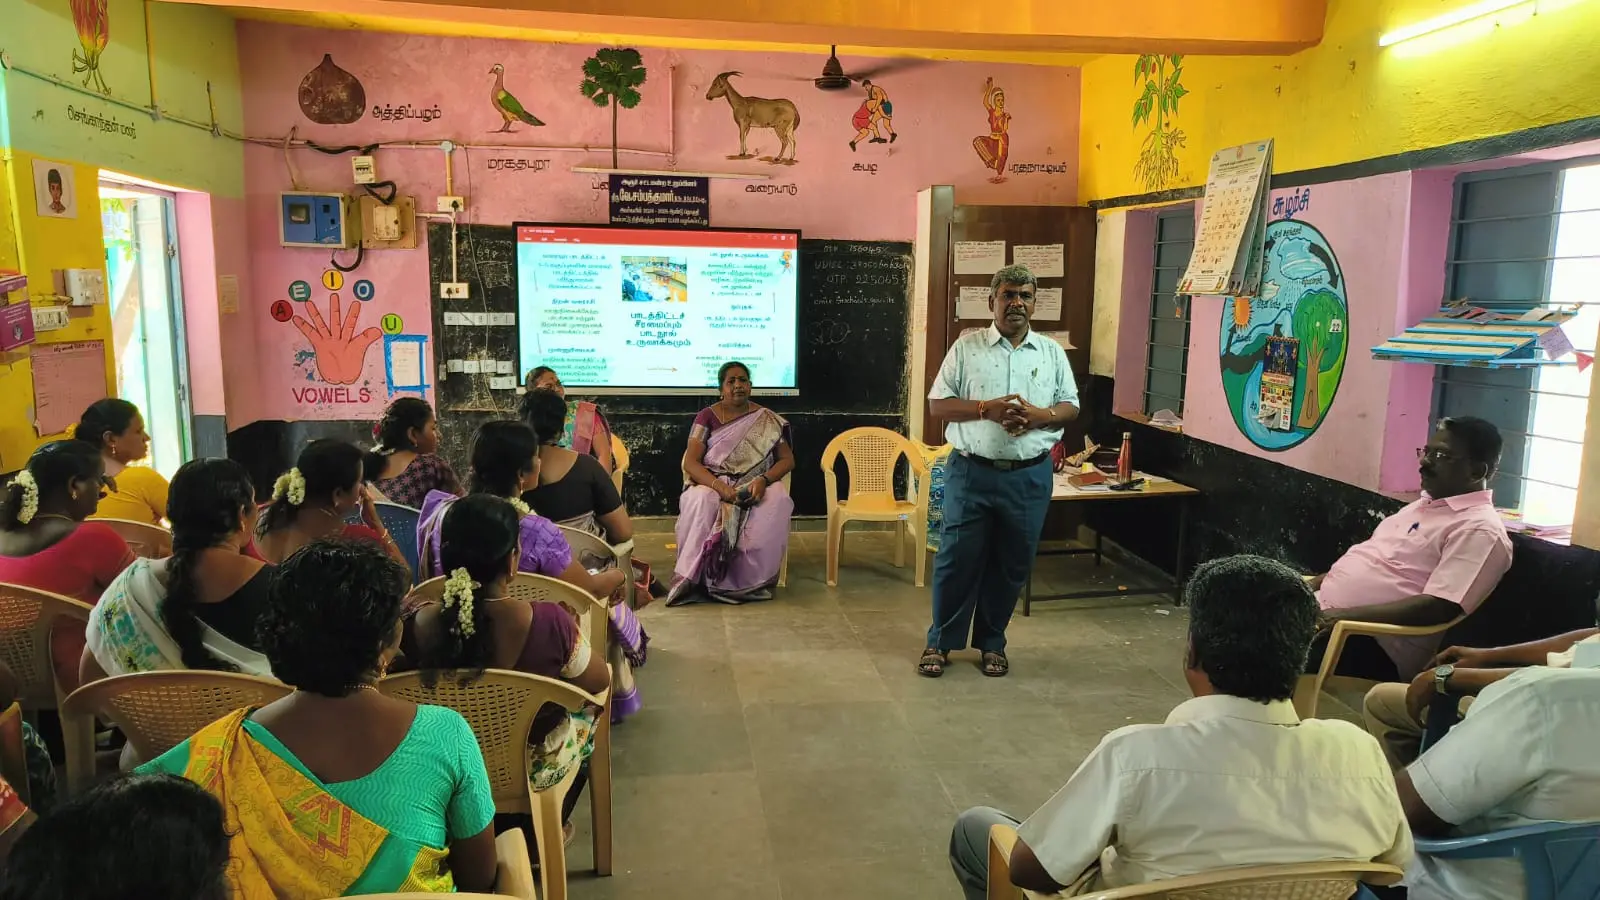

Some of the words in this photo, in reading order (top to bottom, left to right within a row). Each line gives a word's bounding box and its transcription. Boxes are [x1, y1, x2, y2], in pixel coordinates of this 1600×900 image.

[372, 103, 442, 122] அத்திப்பழம்
[487, 158, 551, 173] மரகதபுறா
[852, 162, 878, 175] கபடி
[745, 183, 798, 196] வரையாடு
[292, 284, 306, 298] E
[357, 283, 370, 298] O
[275, 303, 286, 317] A
[384, 317, 397, 331] U
[292, 387, 371, 404] VOWELS
